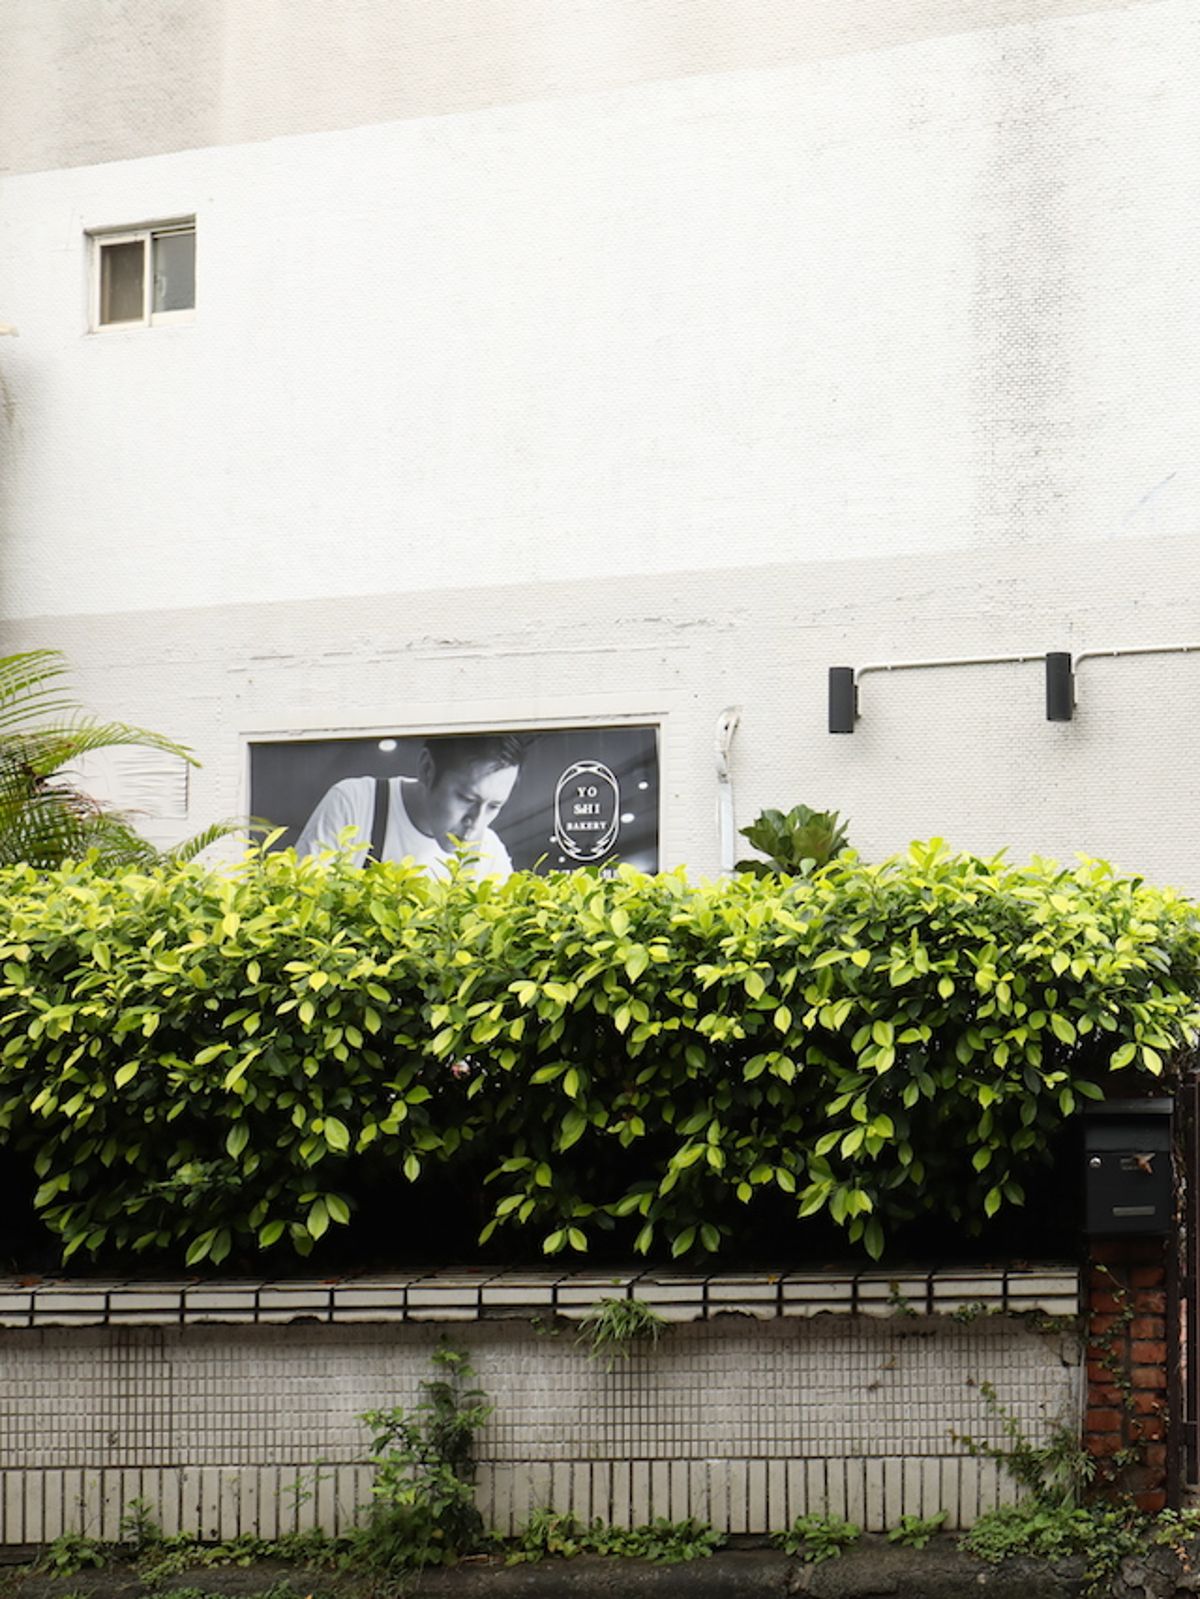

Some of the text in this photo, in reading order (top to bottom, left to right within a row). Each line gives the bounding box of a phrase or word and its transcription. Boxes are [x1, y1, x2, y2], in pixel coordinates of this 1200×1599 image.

[577, 786, 598, 798] YO
[573, 803, 600, 815] SHI
[566, 821, 607, 832] BAKERY
